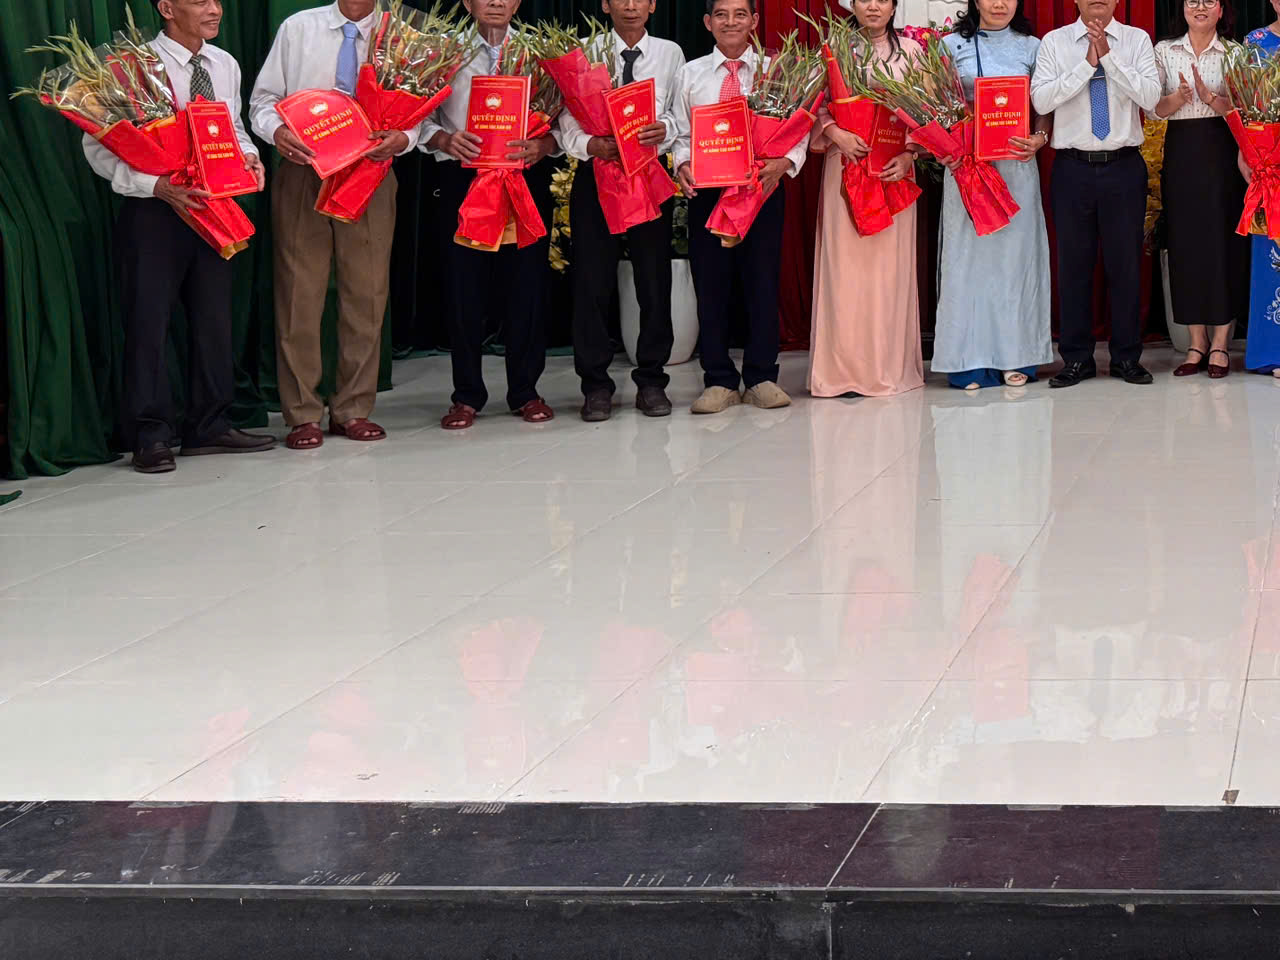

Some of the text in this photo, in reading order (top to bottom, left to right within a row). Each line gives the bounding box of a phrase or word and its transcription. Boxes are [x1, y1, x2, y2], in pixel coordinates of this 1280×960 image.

[472, 112, 516, 123] QUYẾT ĐỊNH
[982, 111, 1021, 120] QUYẾT ĐỊNH
[303, 118, 330, 136] QUYẾT
[699, 136, 744, 147] QUYẾT ĐỊNH
